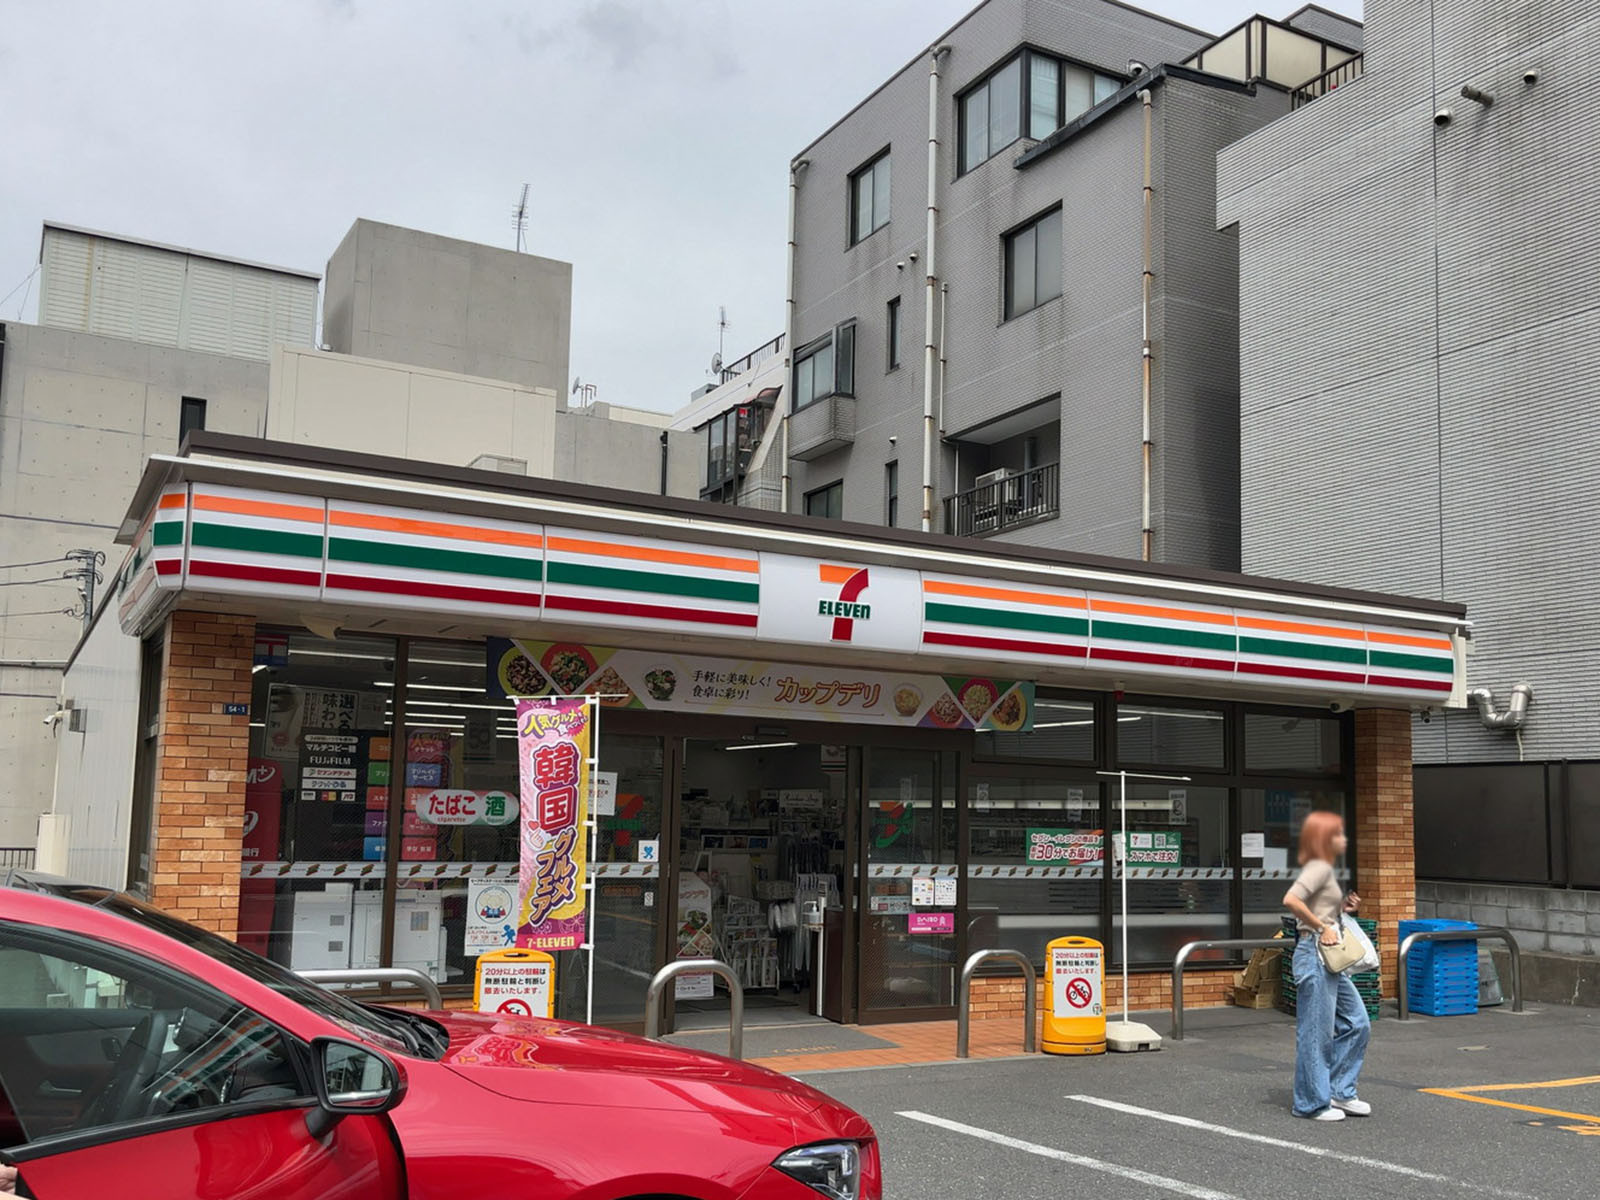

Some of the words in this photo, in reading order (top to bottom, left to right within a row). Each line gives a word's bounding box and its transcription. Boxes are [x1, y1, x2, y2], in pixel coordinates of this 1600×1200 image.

[819, 563, 868, 641] 7
[693, 670, 771, 688] 手軽に美味しく!
[693, 684, 749, 700] 食卓に彩り!
[774, 676, 881, 708] カップデリ
[534, 744, 578, 832] 韓国
[429, 794, 476, 815] たばこ
[486, 796, 506, 816] 酒
[551, 830, 575, 905] グルメ
[528, 850, 557, 923] フェア
[485, 967, 546, 976] 20分以上の駐輪は
[485, 977, 546, 985] 無断駐輪と判断し
[484, 987, 542, 995] 撤去いたします。
